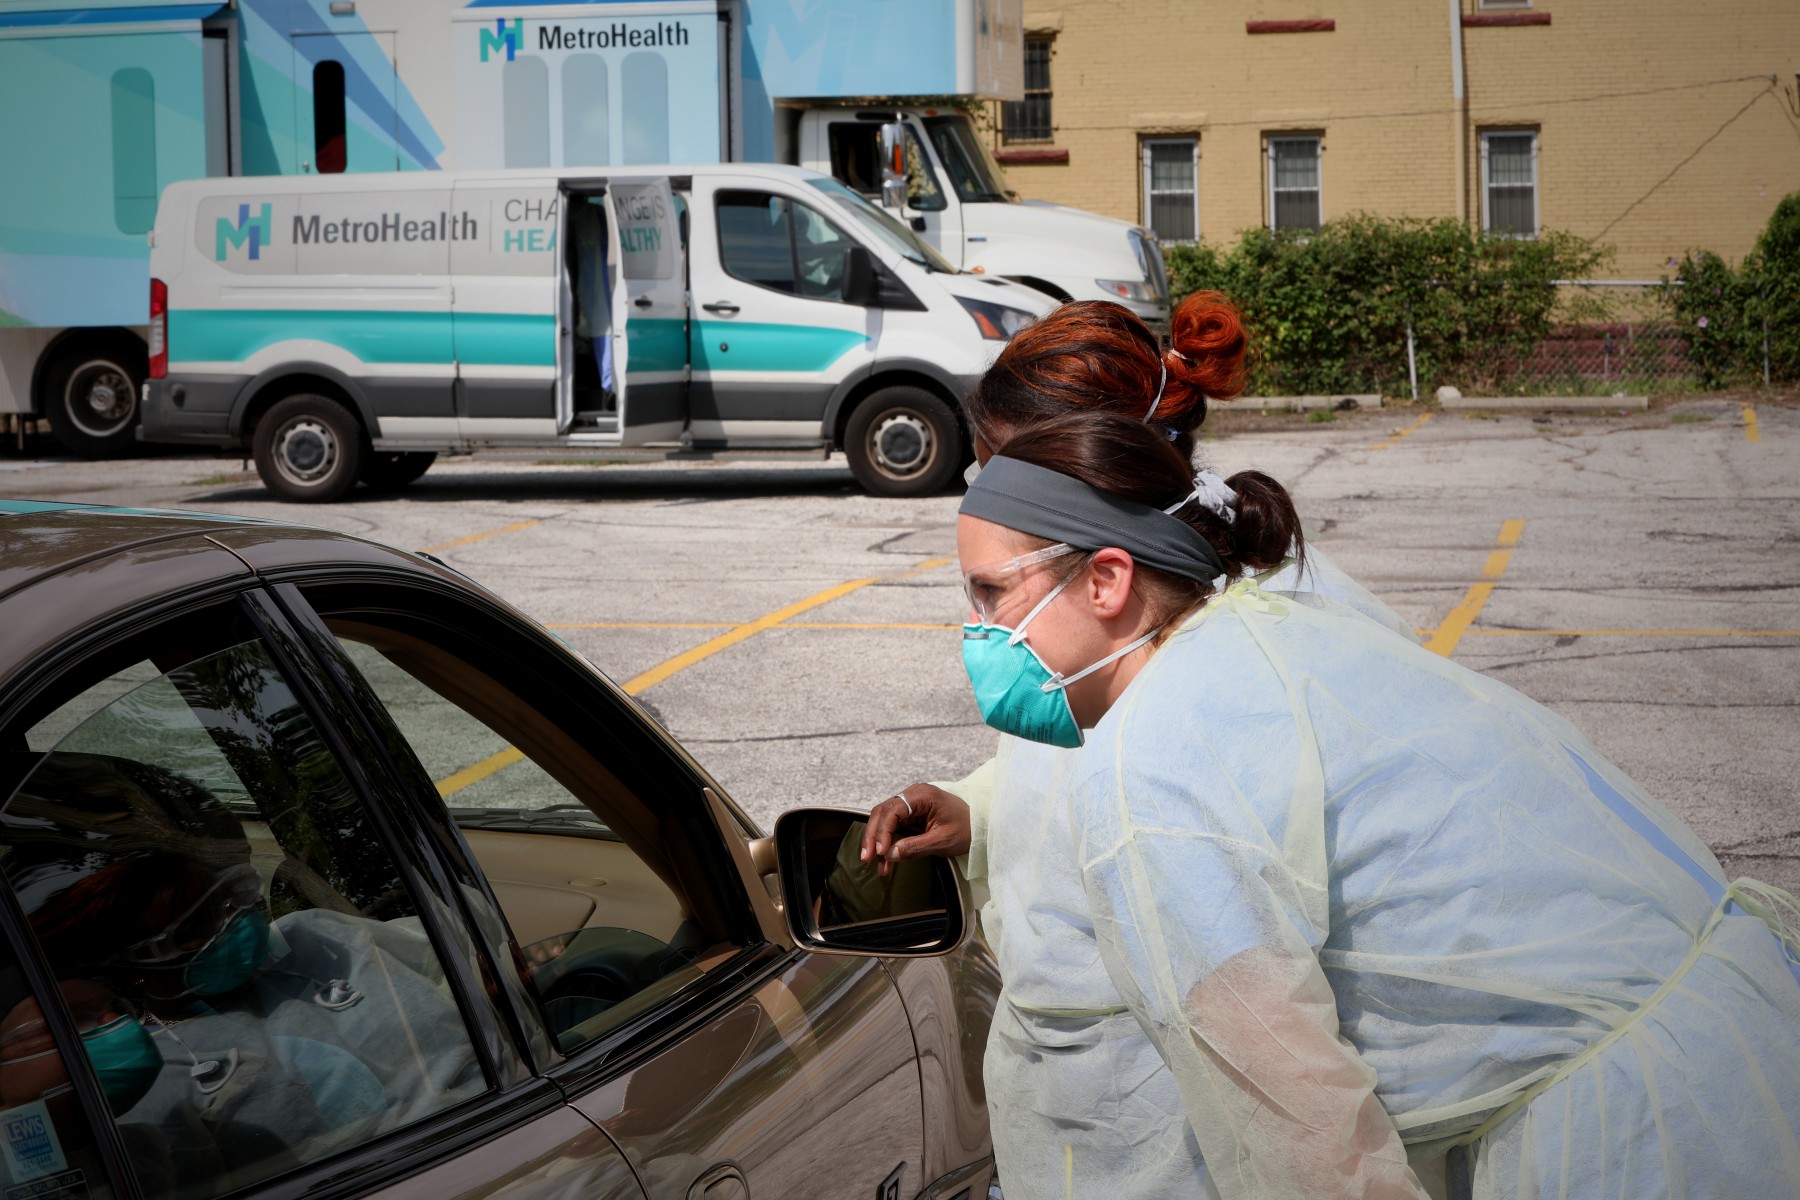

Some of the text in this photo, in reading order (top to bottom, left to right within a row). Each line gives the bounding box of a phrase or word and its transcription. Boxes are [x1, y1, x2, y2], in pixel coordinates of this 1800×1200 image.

[538, 21, 689, 50] MetroHealth
[651, 196, 665, 219] IS
[292, 211, 478, 244] MetroHealth
[6, 1116, 45, 1142] LEWIS
[61, 1174, 79, 1185] LOCK
